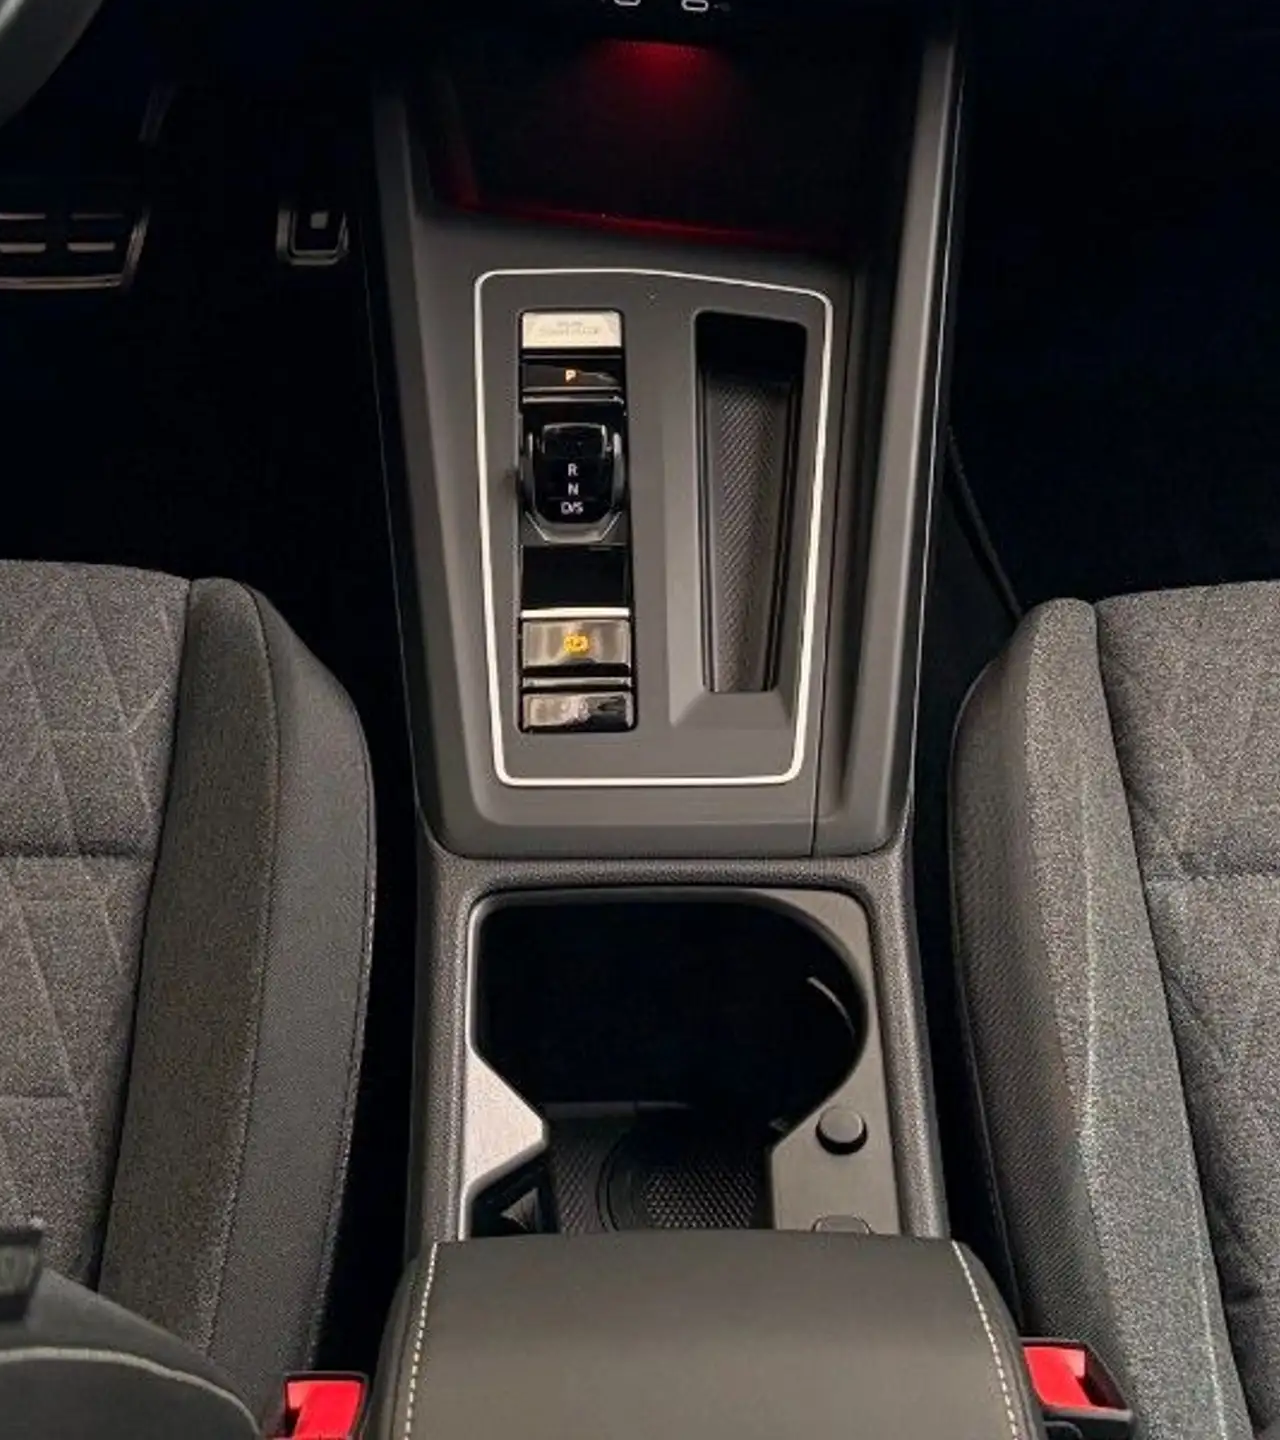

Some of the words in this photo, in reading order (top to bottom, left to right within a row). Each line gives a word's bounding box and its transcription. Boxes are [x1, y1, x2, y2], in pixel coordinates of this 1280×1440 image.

[564, 368, 577, 382] P
[567, 462, 579, 477] R
[567, 481, 579, 496] N
